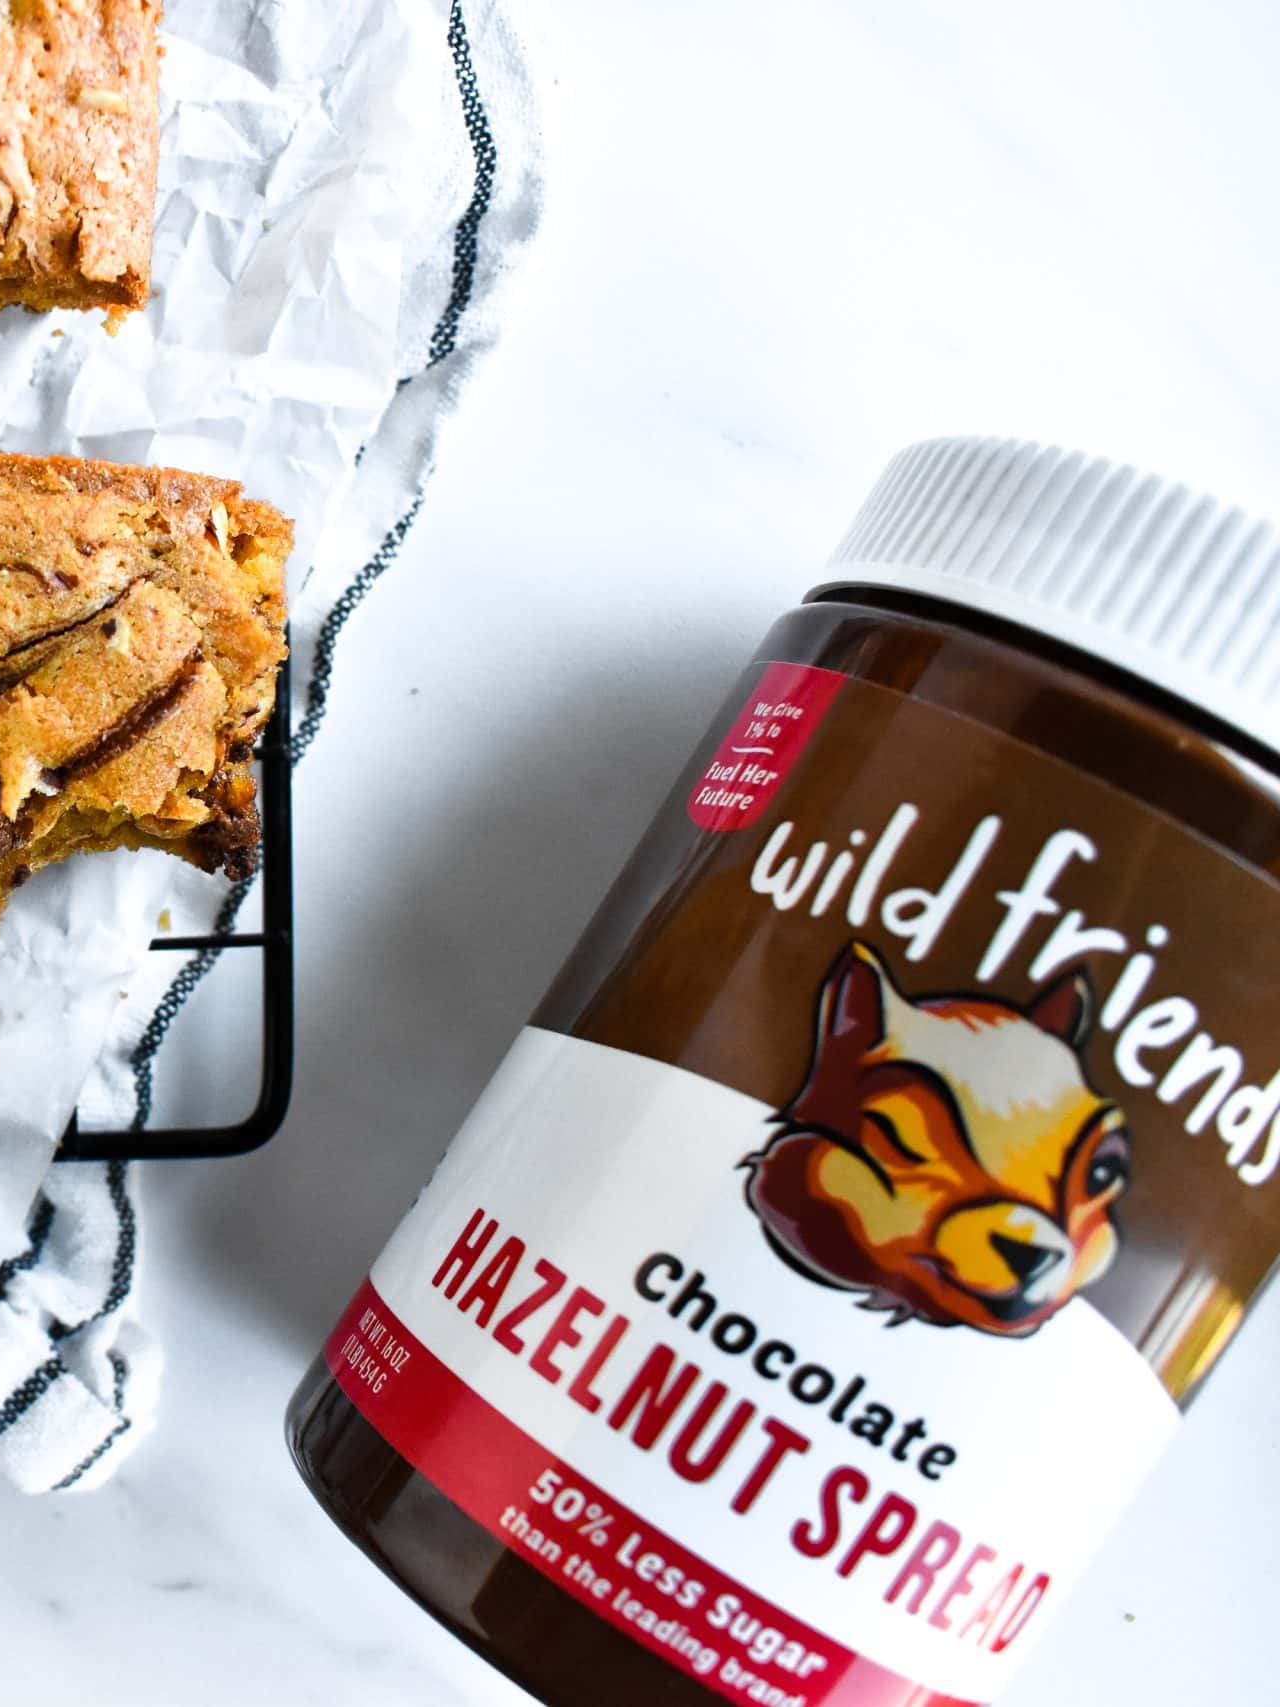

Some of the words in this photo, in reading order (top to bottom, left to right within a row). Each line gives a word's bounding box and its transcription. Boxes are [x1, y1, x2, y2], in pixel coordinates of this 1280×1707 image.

[754, 702, 772, 717] We
[772, 703, 803, 719] Give
[744, 721, 767, 738] 1%
[705, 761, 742, 782] Fuel
[739, 764, 777, 786] Her
[695, 786, 754, 810] Future
[751, 803, 1001, 961] wild
[358, 1308, 377, 1334] NET
[367, 1320, 387, 1350] WT.
[381, 1335, 397, 1359] 16
[390, 1346, 411, 1374] OZ
[358, 1356, 380, 1386] 454
[372, 1372, 388, 1394] G
[634, 1252, 957, 1480] Chocolate
[432, 1208, 811, 1515] HAZELNUT
[790, 1465, 1051, 1653] SPREAD
[528, 1469, 614, 1547] 50%
[616, 1532, 706, 1608] Less
[706, 1593, 827, 1678] Sugar
[499, 1505, 562, 1563] than
[562, 1545, 612, 1598] the
[612, 1588, 720, 1674] leading
[720, 1656, 807, 1707] brand
